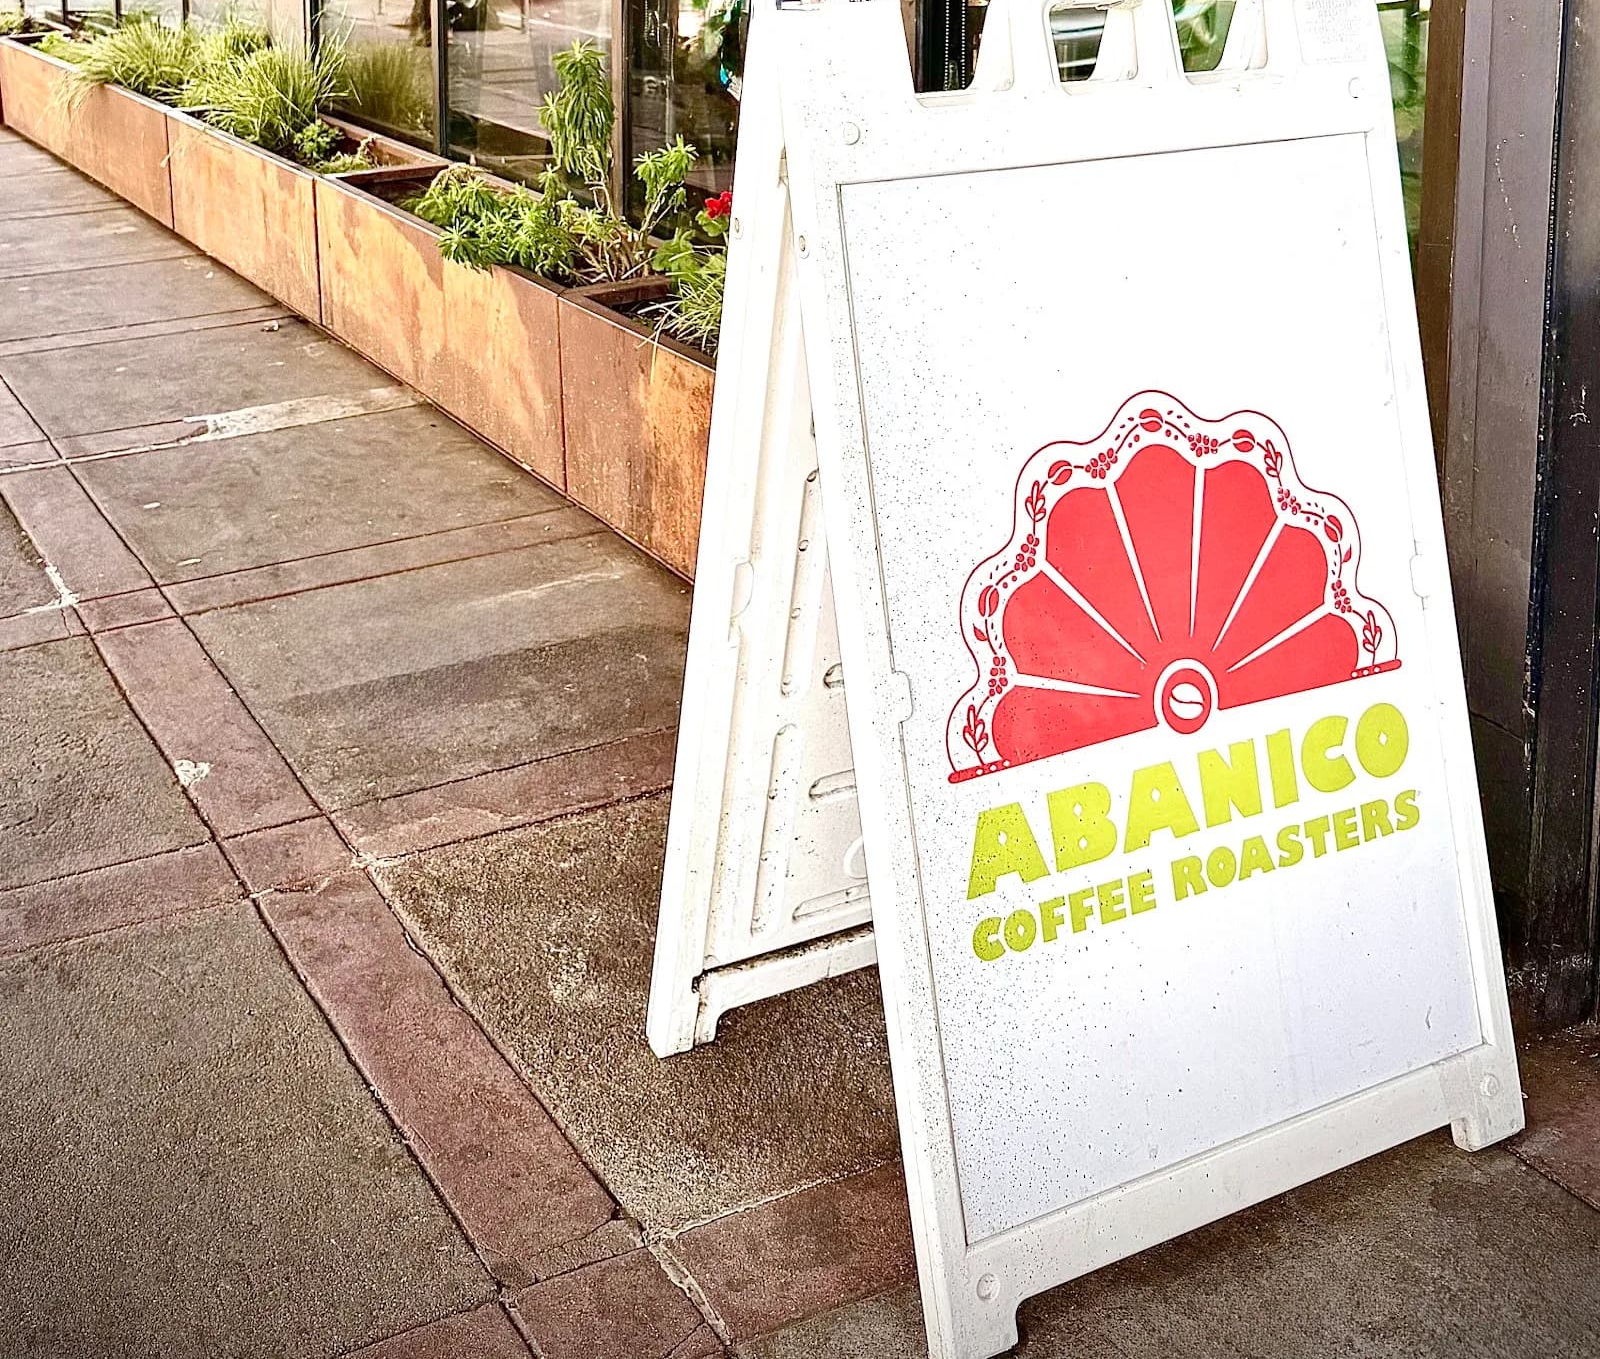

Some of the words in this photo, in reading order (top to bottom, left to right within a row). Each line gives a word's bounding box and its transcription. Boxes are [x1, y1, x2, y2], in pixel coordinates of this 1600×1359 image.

[967, 703, 1409, 900] ABANICO
[972, 871, 1157, 961] COFFEE
[1171, 790, 1420, 901] ROASTERS
